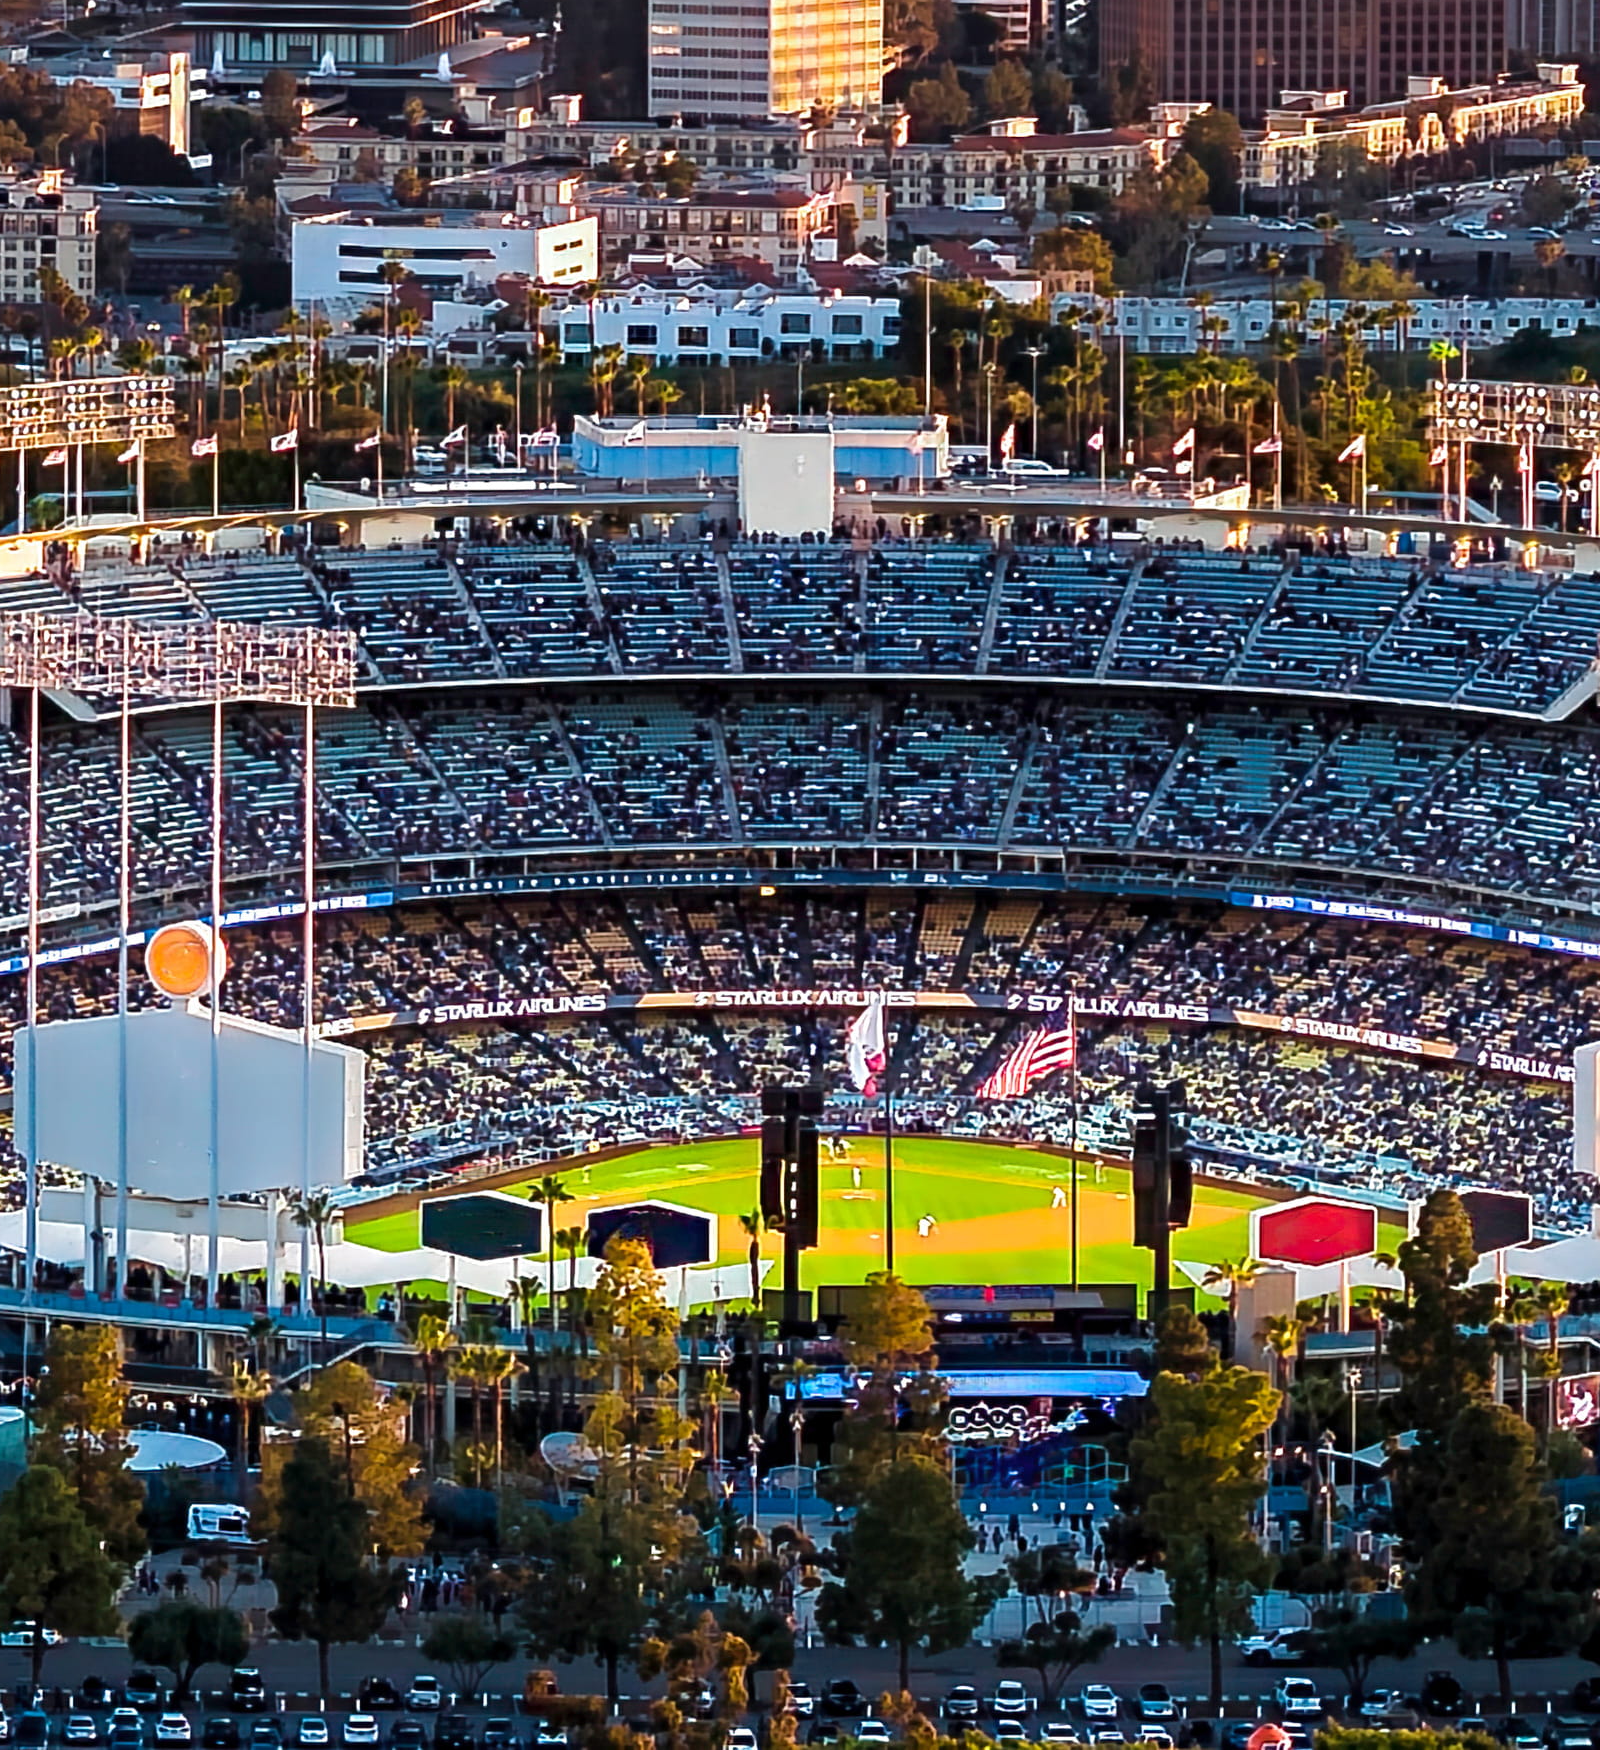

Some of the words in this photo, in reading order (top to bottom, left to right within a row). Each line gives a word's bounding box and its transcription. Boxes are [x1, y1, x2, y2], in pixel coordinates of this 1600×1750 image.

[433, 1001, 514, 1024] STARLUX
[517, 994, 607, 1016] AIRLINES
[714, 990, 813, 1007] STARLUX
[815, 990, 917, 1007] AIRLINES
[1027, 995, 1120, 1017] STRLUX
[1122, 1000, 1209, 1023] AIRLINES
[1295, 1018, 1361, 1043] STARLUX
[1360, 1028, 1424, 1053] AIRLINES
[1490, 1053, 1553, 1079] STARLUX
